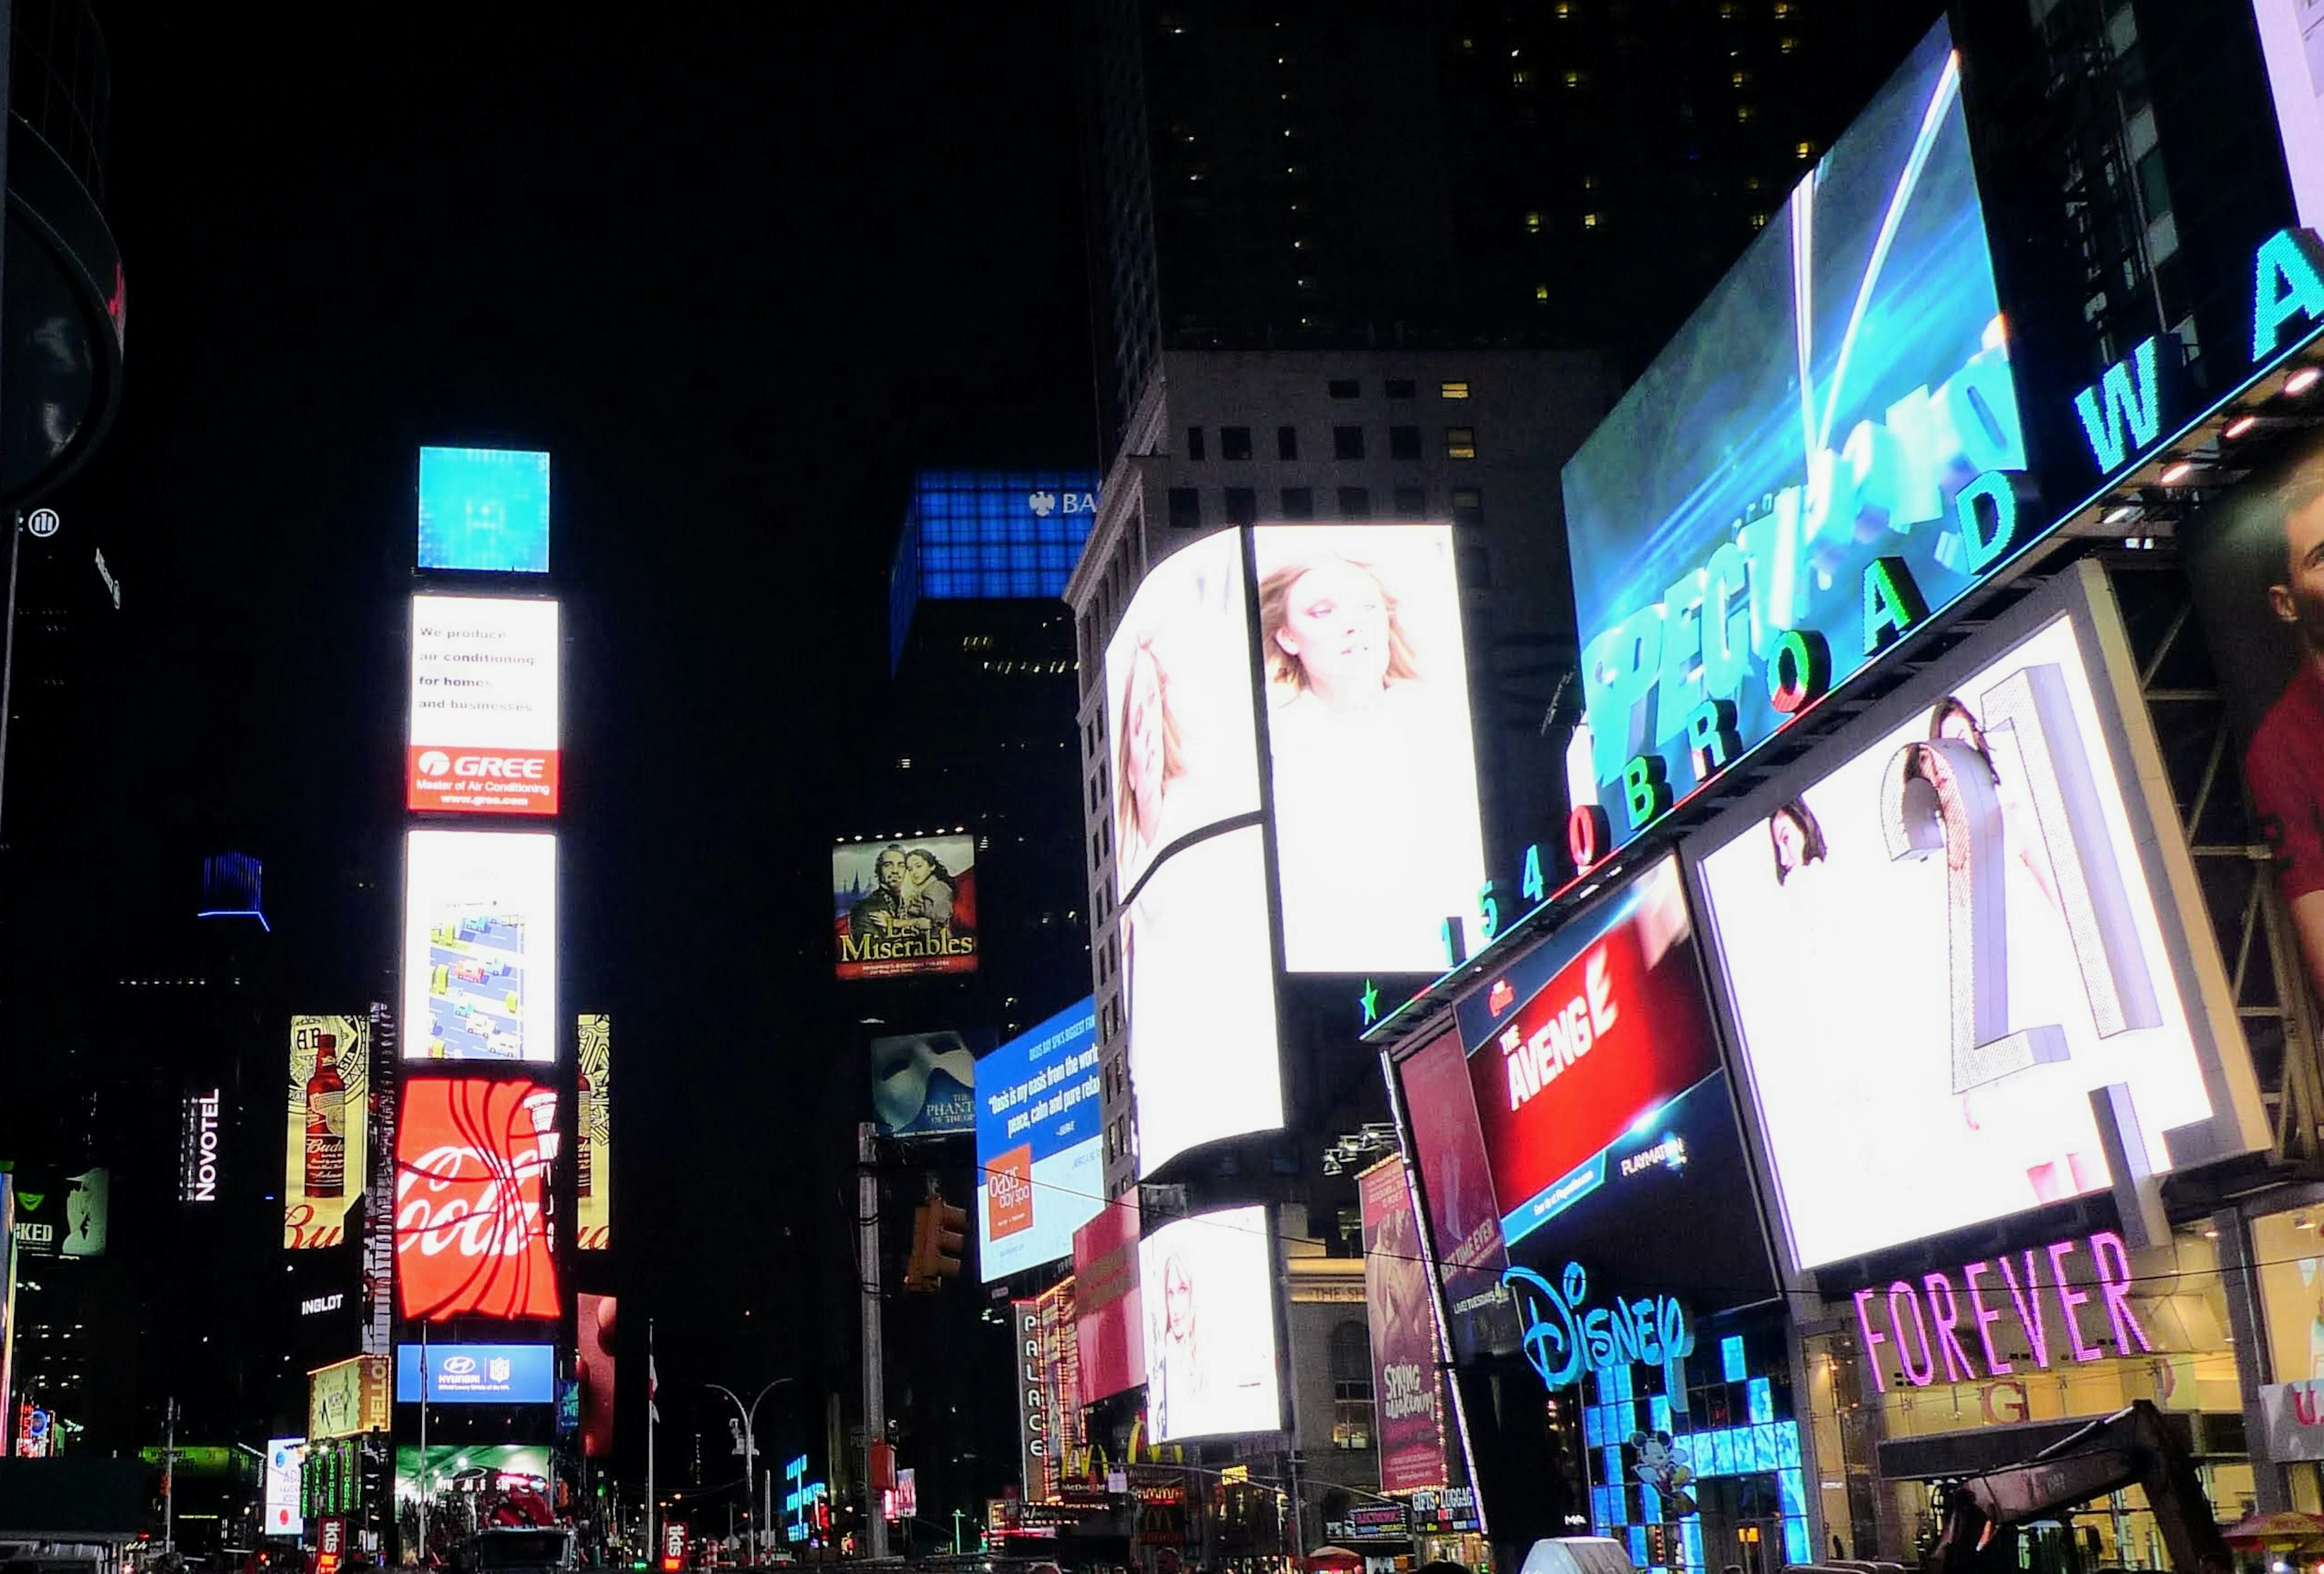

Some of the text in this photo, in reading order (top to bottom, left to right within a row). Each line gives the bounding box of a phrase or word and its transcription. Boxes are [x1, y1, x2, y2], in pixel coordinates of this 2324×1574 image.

[420, 626, 506, 639] We produce
[419, 653, 535, 667] air conditioning
[419, 676, 493, 688] for homes
[418, 699, 533, 712] and businesses
[453, 756, 545, 779] GREE
[416, 779, 550, 795] Master of Air Conditioning
[441, 794, 529, 808] www.gree.com
[885, 917, 919, 939] Les
[839, 926, 973, 961] Misérables
[1499, 1024, 1521, 1056] THE
[195, 1088, 220, 1202] NOVOTEL
[301, 1293, 344, 1316] INGLOT
[1853, 1230, 2152, 1394] FOREVER
[438, 1374, 481, 1384] HYUNDAI
[1024, 1316, 1044, 1457] PALACE
[1412, 1490, 1437, 1512] GIFTS
[325, 1521, 341, 1553] tkts
[668, 1524, 685, 1557] tkts
